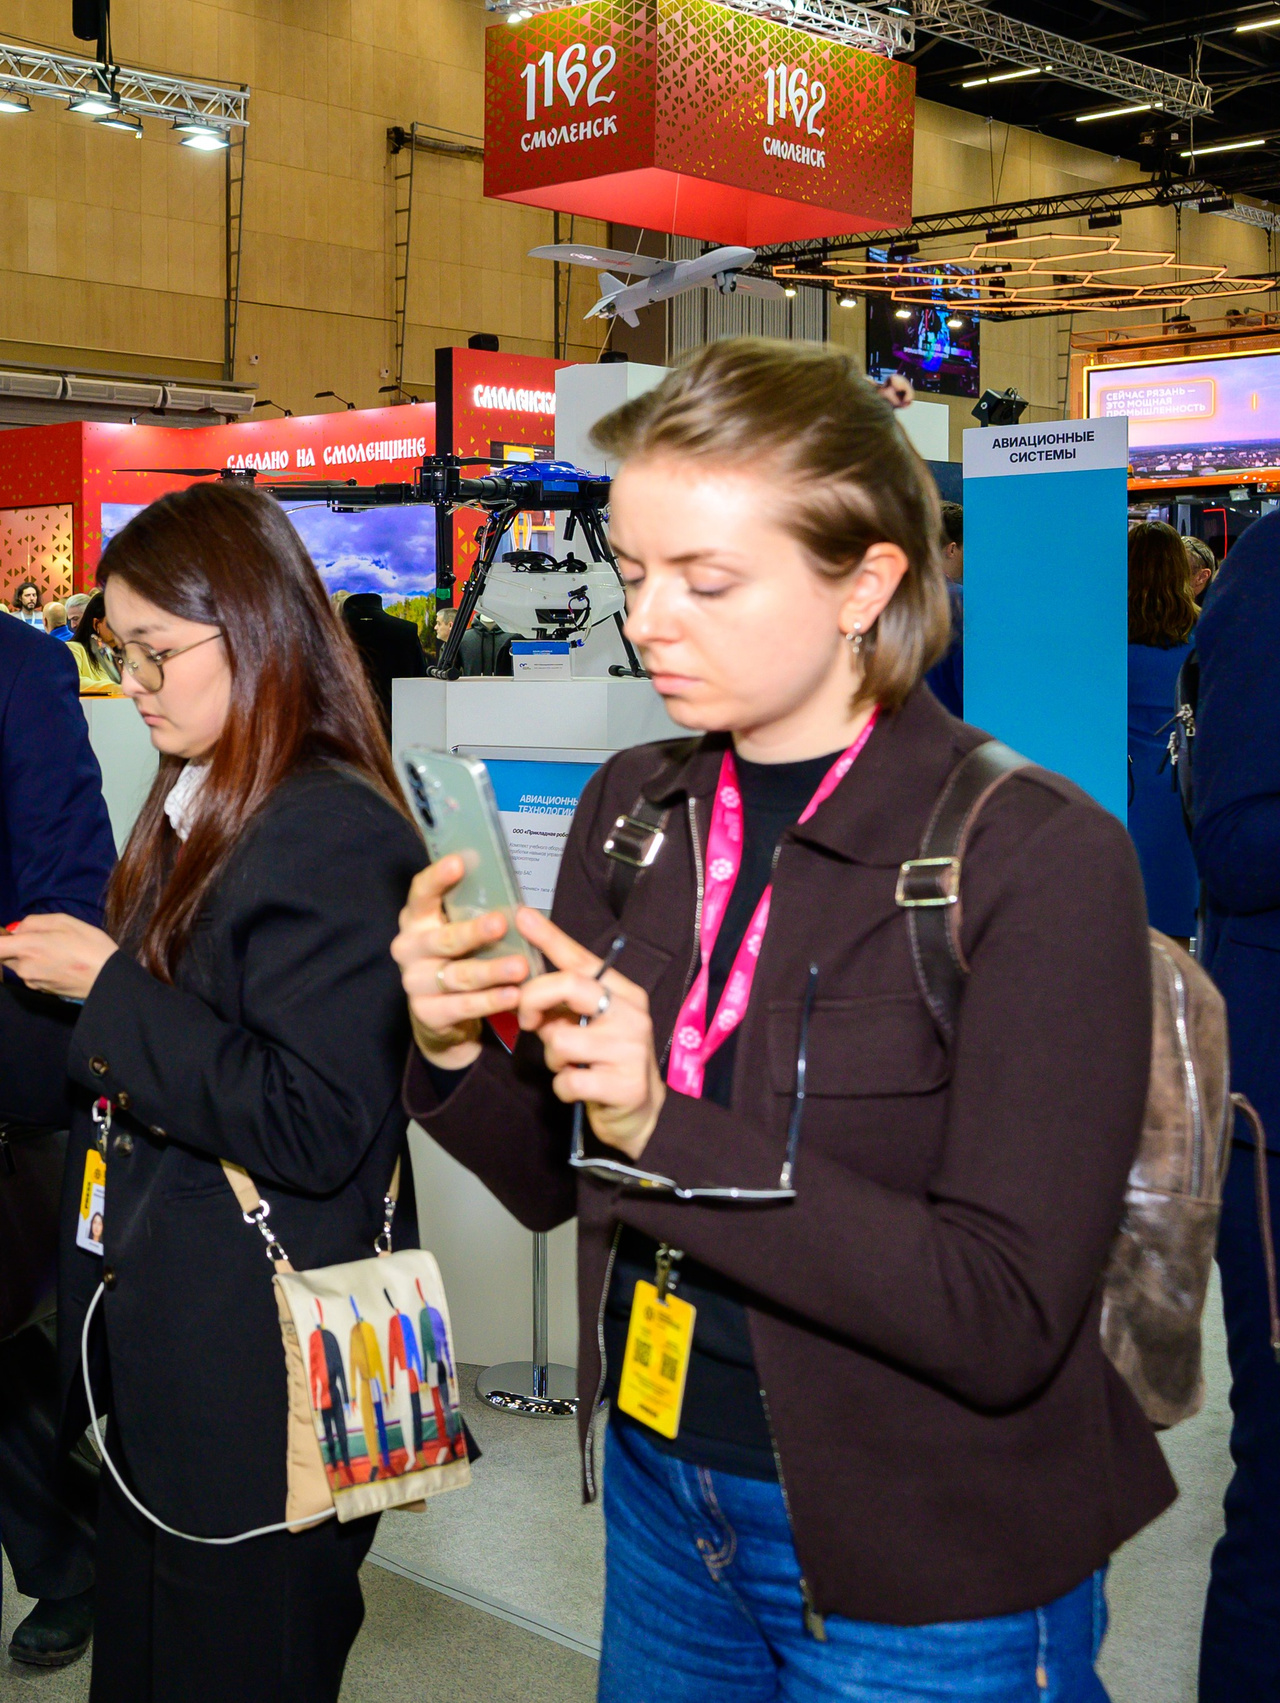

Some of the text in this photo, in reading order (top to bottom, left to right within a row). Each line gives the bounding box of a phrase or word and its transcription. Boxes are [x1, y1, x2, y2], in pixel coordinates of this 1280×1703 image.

[520, 43, 616, 121] 1162
[763, 62, 826, 138] 1162
[520, 115, 618, 152] СМОЛЕНСК
[763, 136, 826, 168] СМОЛЕНСК
[1106, 389, 1145, 401] СЕЙЧАС
[1146, 386, 1186, 399] РЯЗАНЬ
[1106, 397, 1173, 410] ЭТО МОЩНАЯ
[1106, 403, 1207, 417] ПРОМЫШЛЕННОСТЬ
[992, 431, 1095, 449] АВИАЦИОННЫЕ
[297, 447, 316, 468] НА
[323, 437, 426, 466] СМОЛЕНЩИНЕ
[1009, 448, 1077, 463] СИСТЕМЫ
[518, 805, 575, 816] ТЕХНОЛОГИИ
